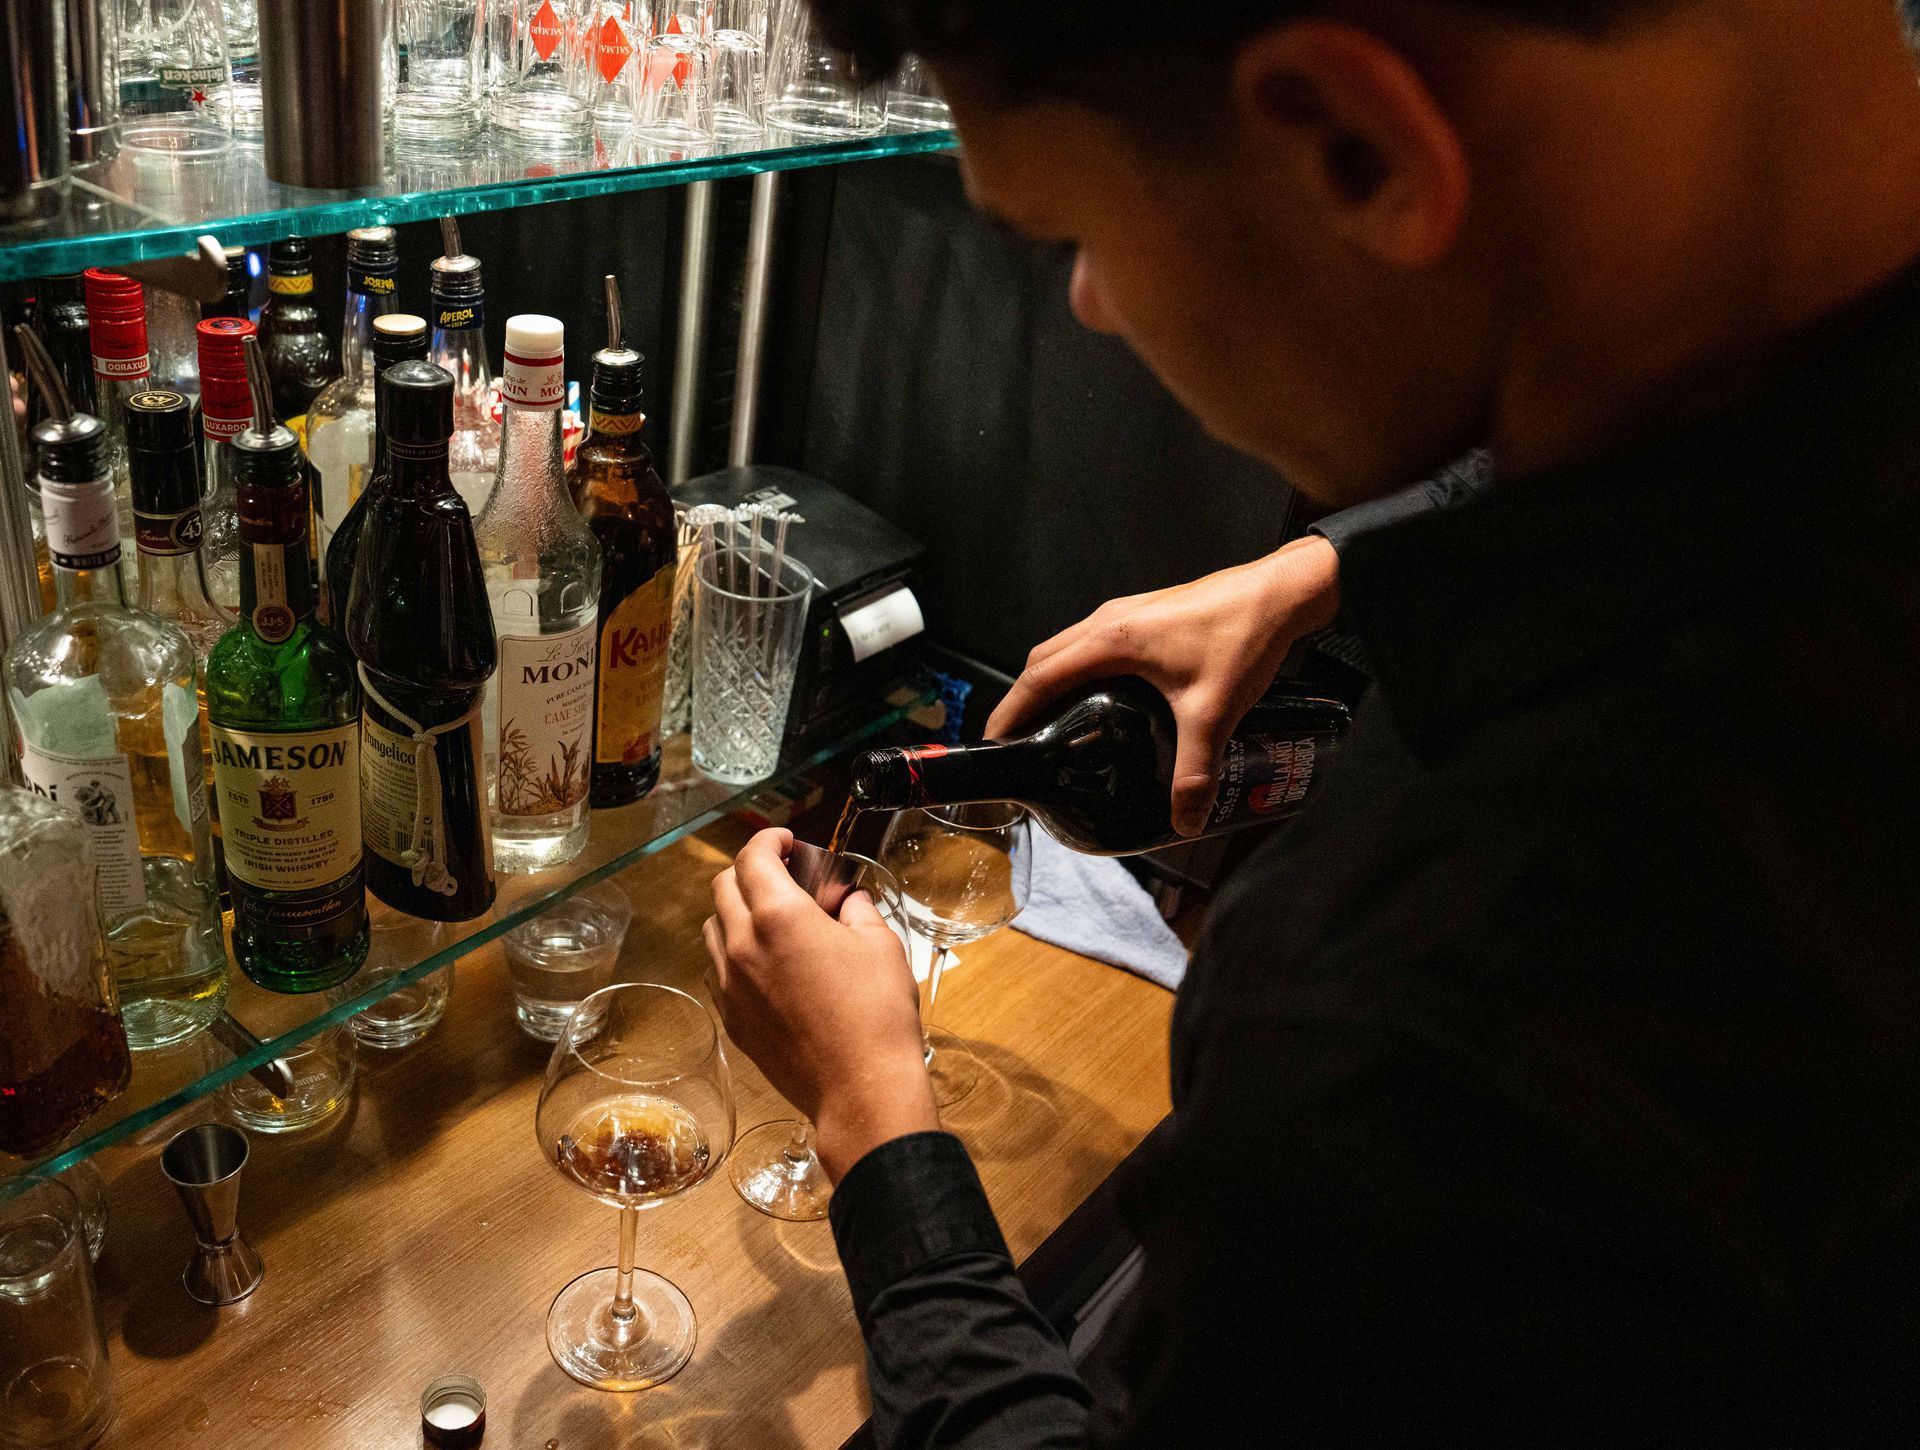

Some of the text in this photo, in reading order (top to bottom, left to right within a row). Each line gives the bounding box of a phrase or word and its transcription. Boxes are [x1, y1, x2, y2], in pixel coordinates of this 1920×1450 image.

[599, 44, 631, 55] SALMA
[163, 68, 224, 83] Heineken
[440, 308, 474, 324] APEROL
[503, 382, 528, 397] NIN
[540, 384, 564, 397] MON
[206, 419, 247, 432] LUXARDO
[181, 514, 202, 538] 43
[537, 643, 562, 662] Le
[521, 648, 594, 684] MONI
[546, 692, 566, 704] PURE
[545, 709, 572, 724] CANE
[364, 719, 416, 766] Frangelico
[212, 738, 348, 770] JAMESON
[1275, 740, 1293, 764] AND
[1284, 737, 1316, 803] 100% ARABICA
[1214, 738, 1240, 823] COLD BREW
[1262, 765, 1291, 808] VANILLA
[234, 828, 335, 846] TRIPLE DISTILLED
[244, 858, 330, 873] IRISH WHISKEY
